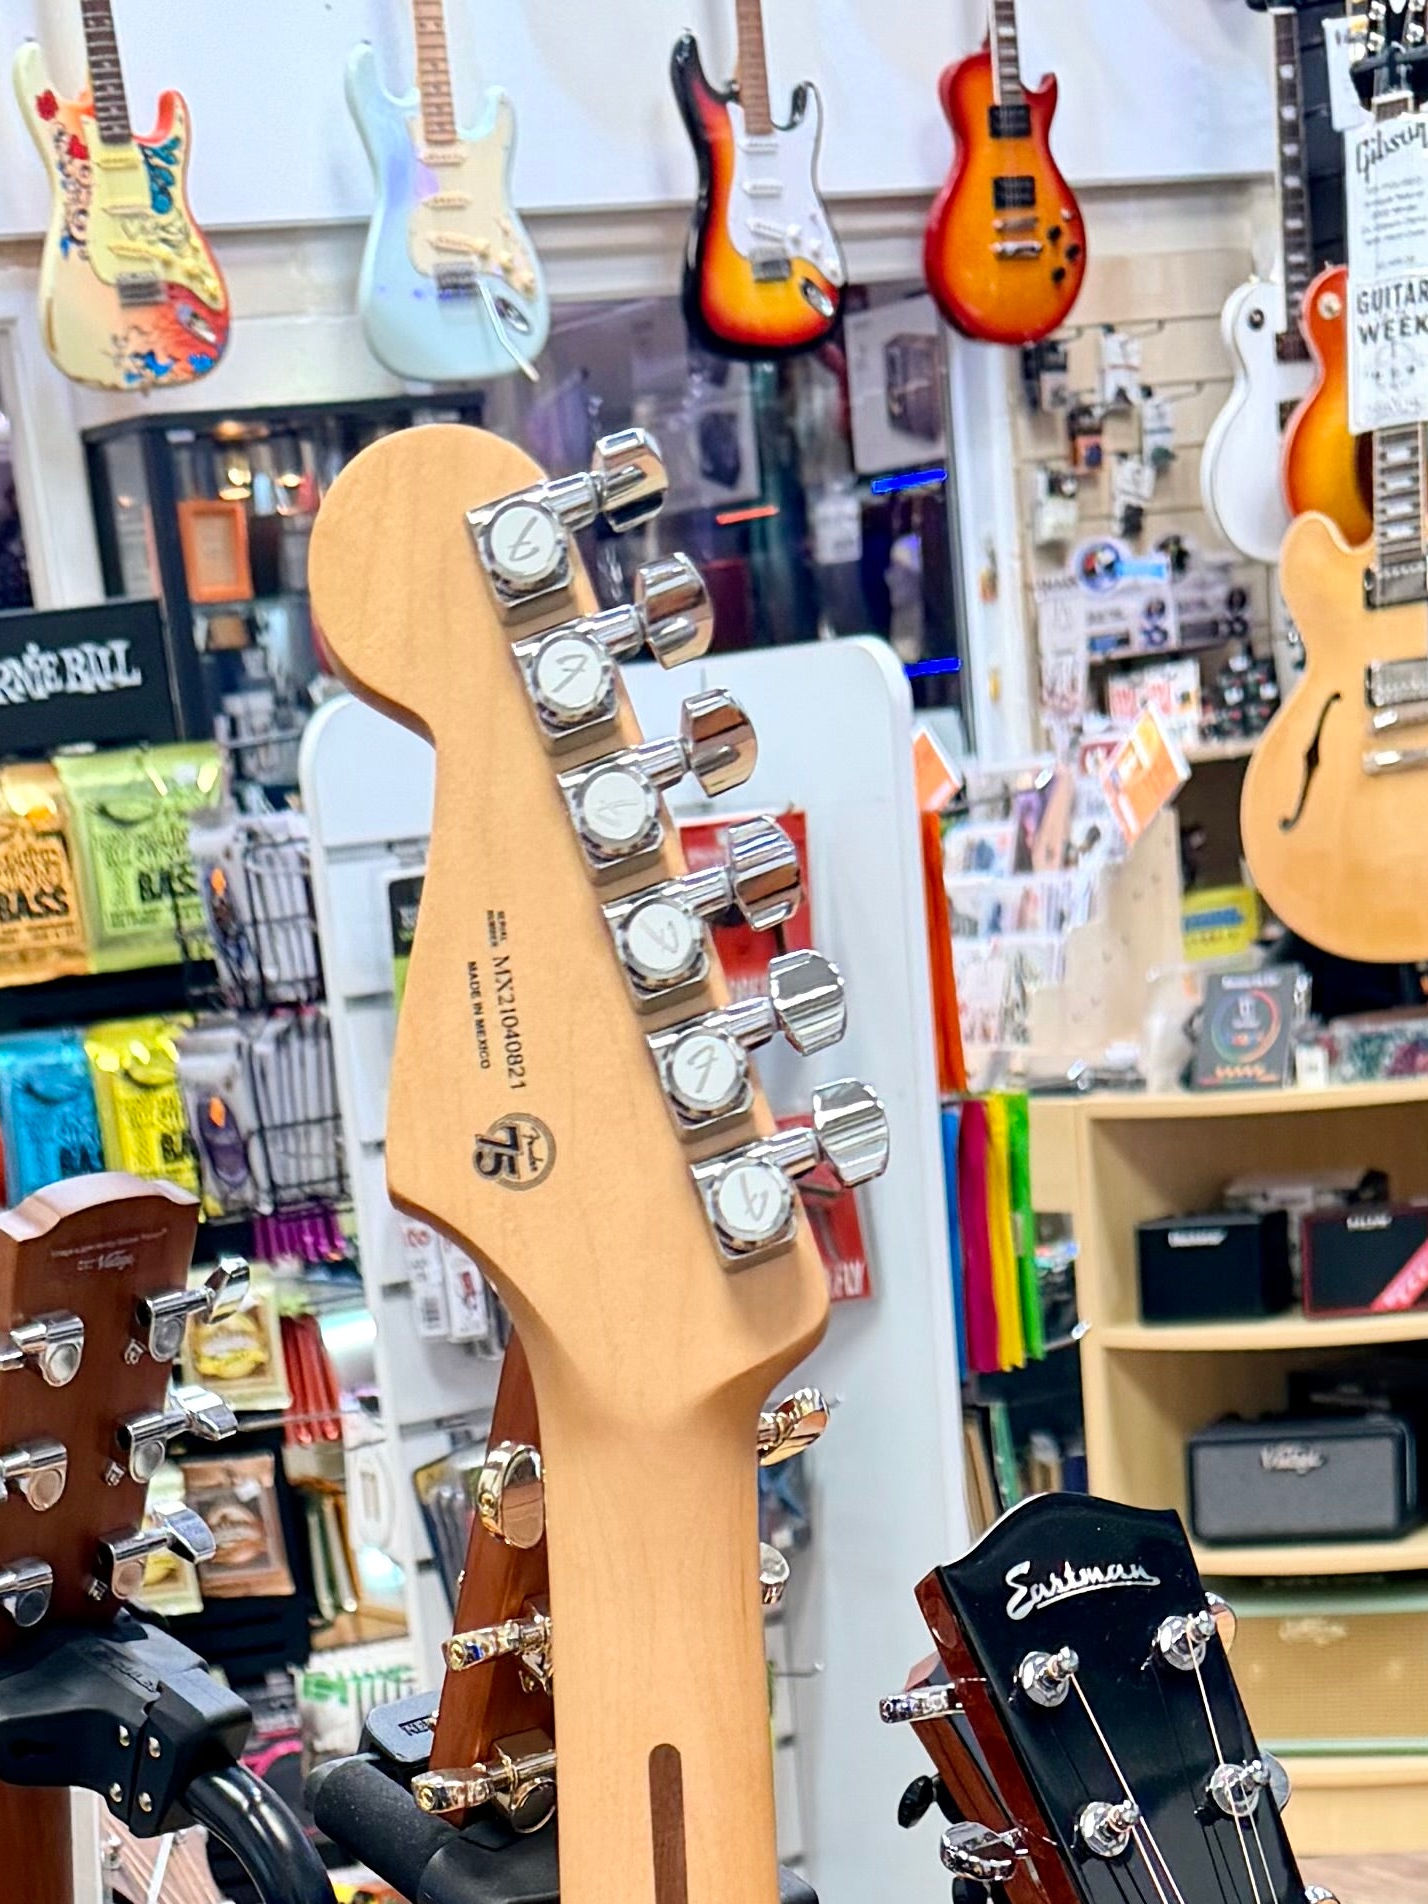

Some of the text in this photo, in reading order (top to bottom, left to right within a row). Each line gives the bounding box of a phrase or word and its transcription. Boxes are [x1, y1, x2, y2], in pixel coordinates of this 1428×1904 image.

[62, 639, 143, 695] BALL
[468, 961, 491, 1069] MADE IN MEXICO
[492, 955, 527, 1090] MX21040821
[1005, 1560, 1161, 1621] Eastman
